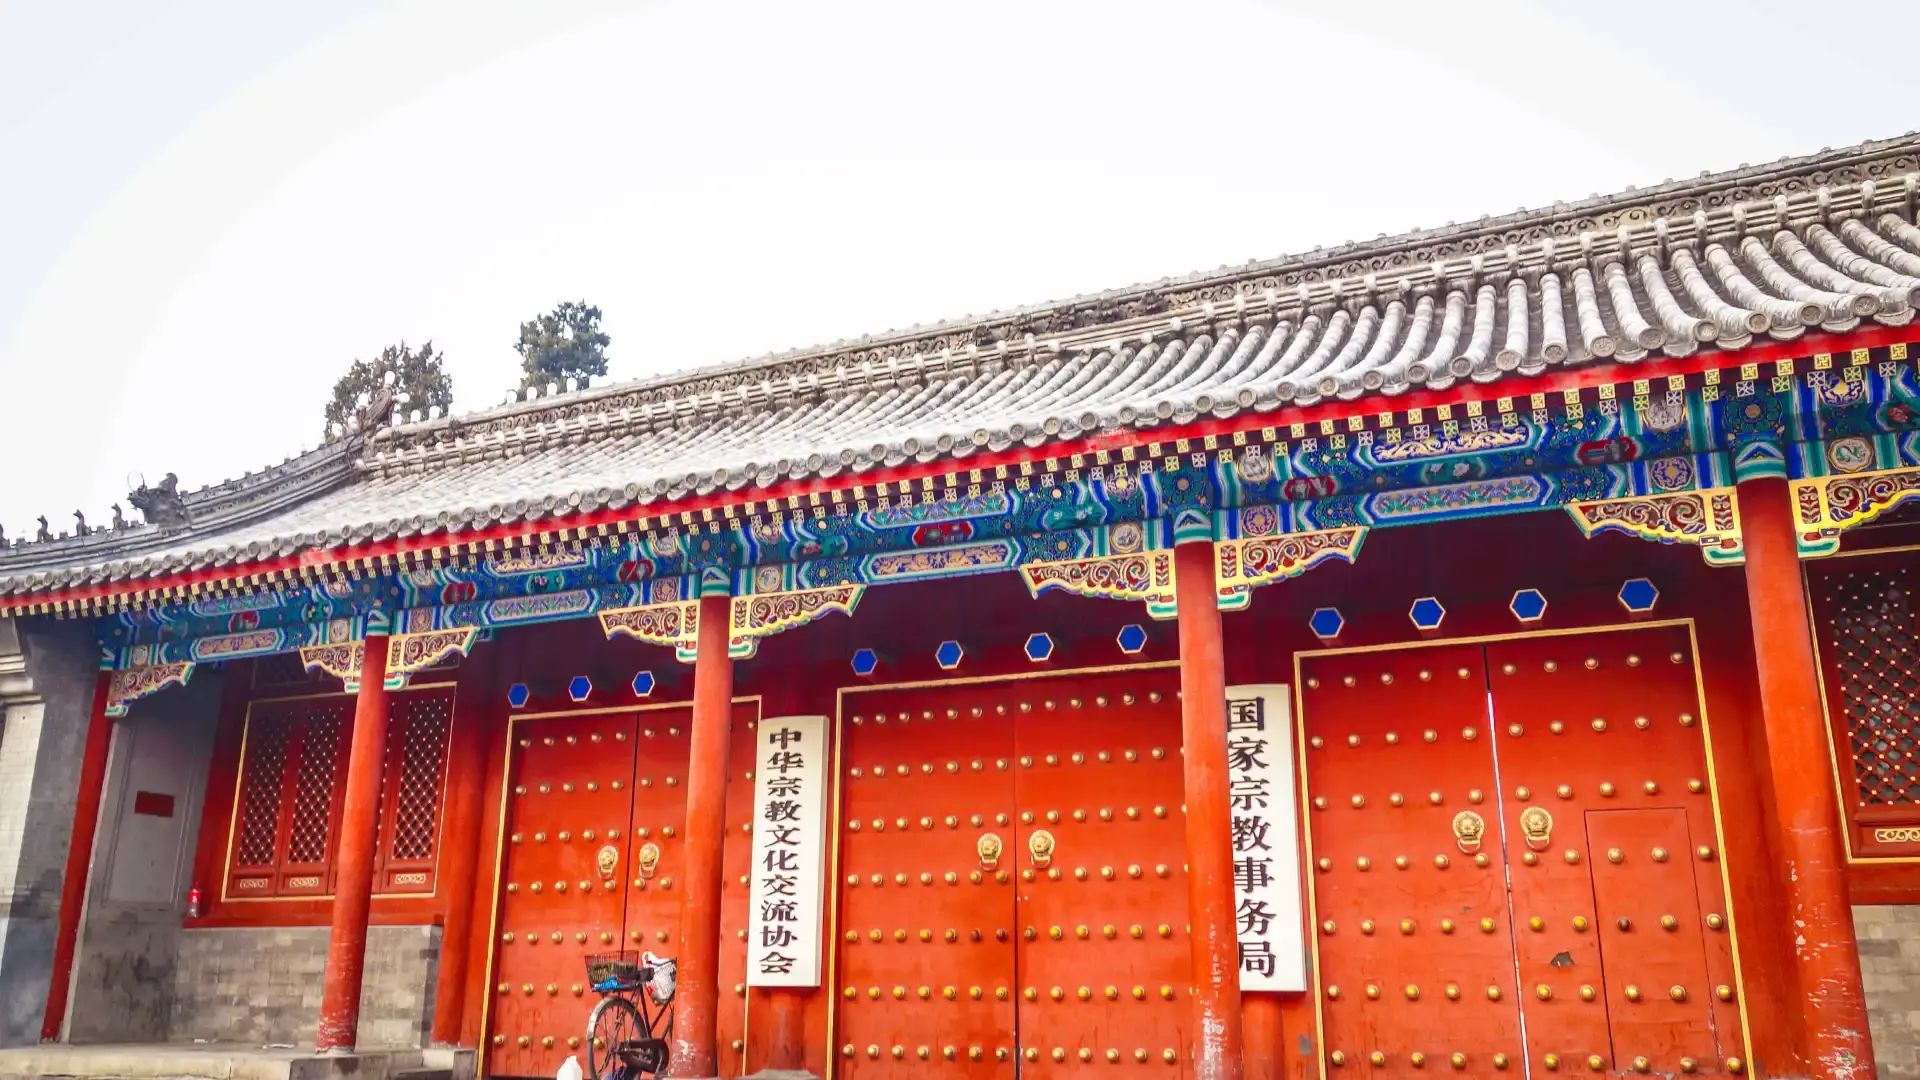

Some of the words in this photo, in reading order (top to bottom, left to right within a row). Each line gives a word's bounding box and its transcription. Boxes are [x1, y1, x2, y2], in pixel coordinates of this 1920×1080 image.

[759, 727, 804, 974] 中华宗教文化交流协会
[1226, 696, 1277, 978] 国家宗教事务局
